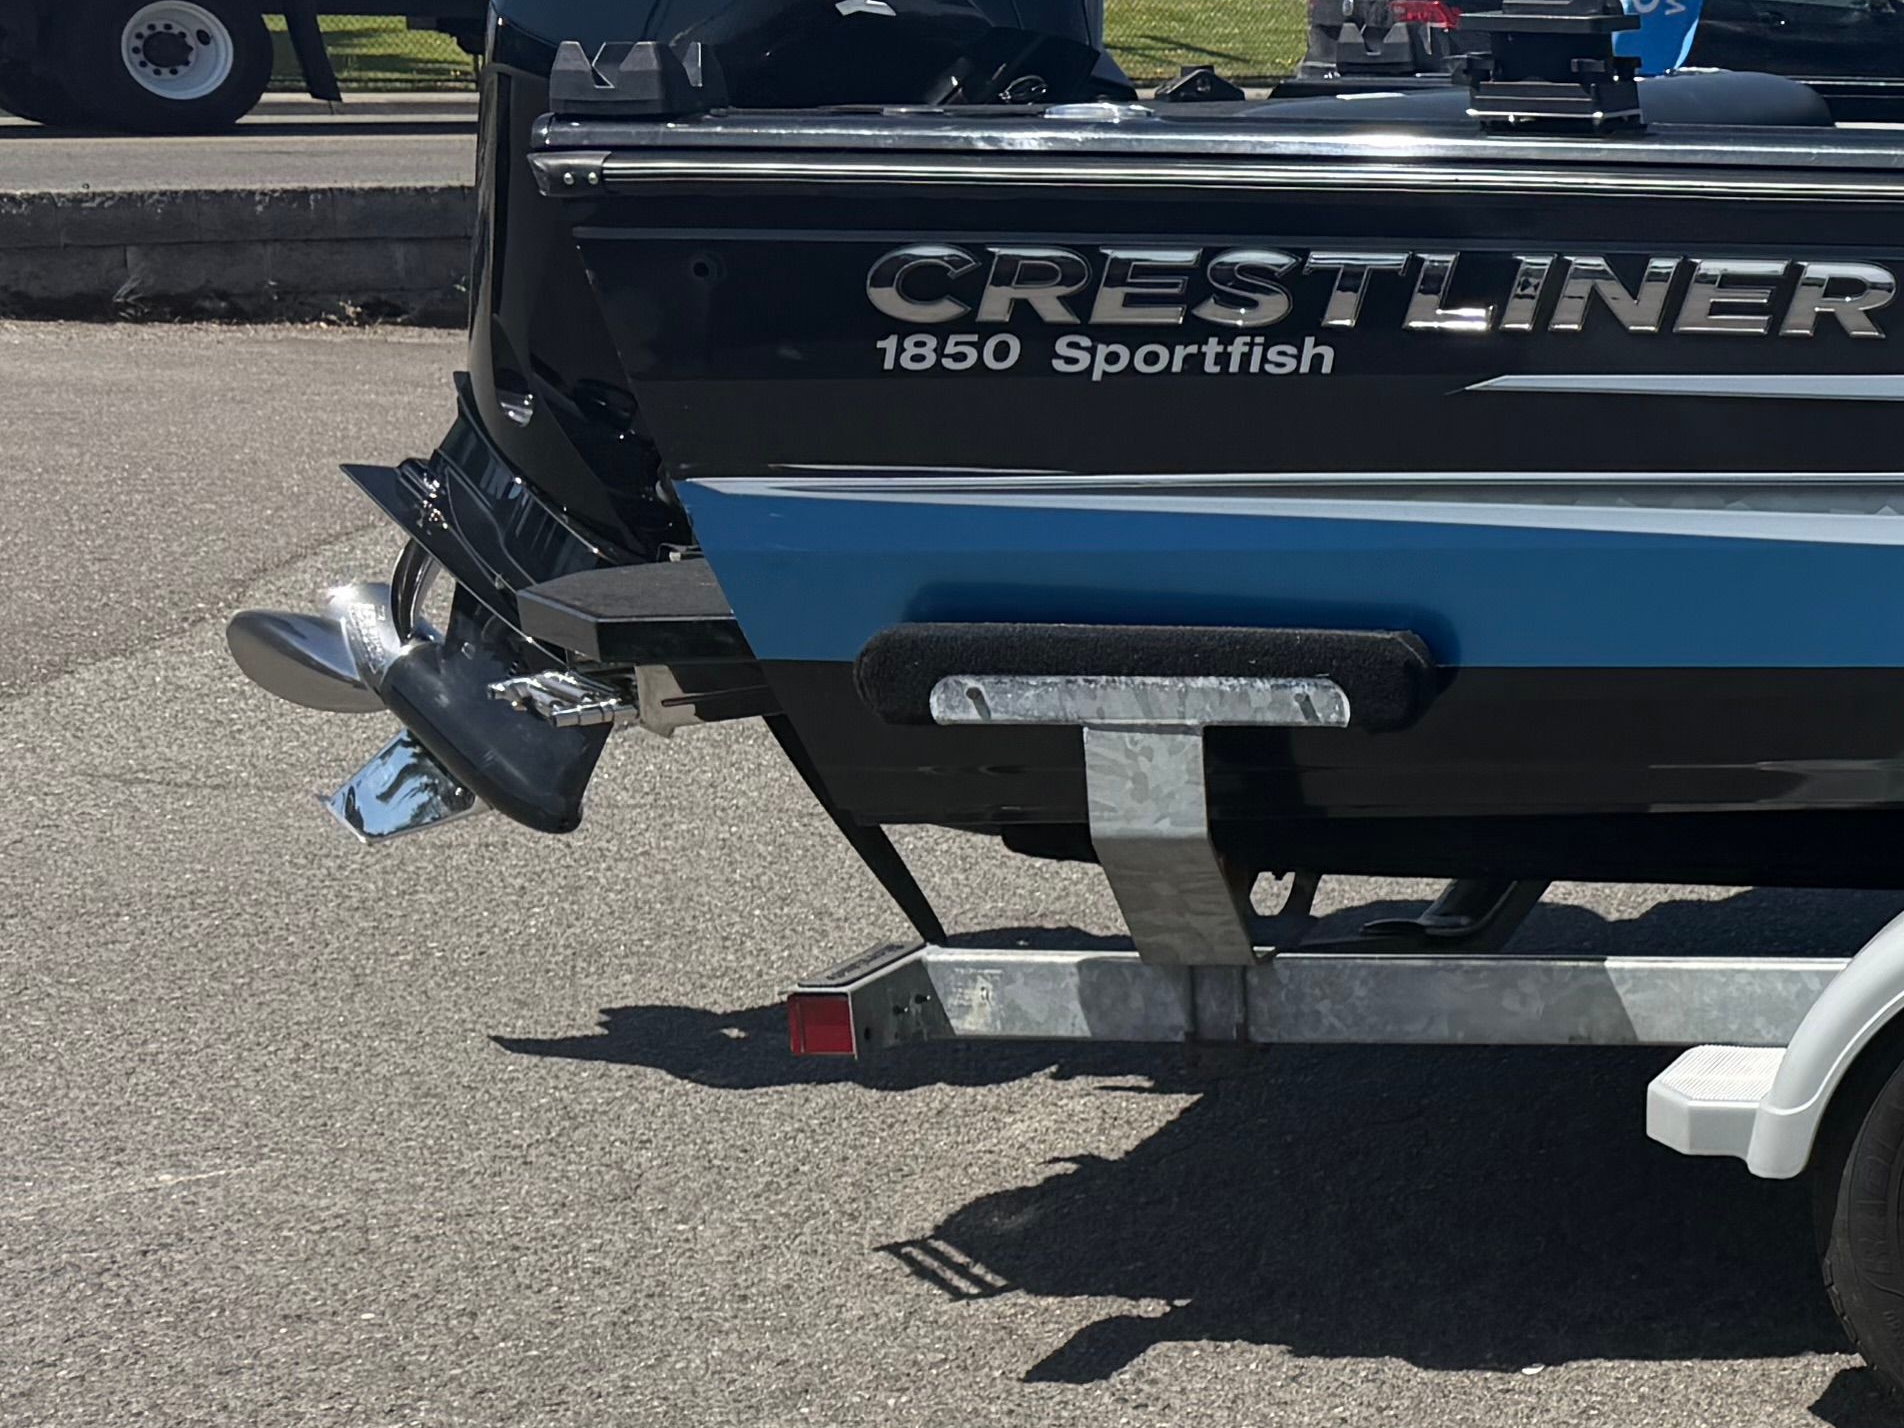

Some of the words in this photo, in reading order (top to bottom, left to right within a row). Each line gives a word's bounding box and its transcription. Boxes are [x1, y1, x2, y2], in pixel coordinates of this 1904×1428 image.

[864, 243, 1898, 341] CRESTLINER
[876, 334, 1021, 371] 1850
[1051, 334, 1335, 381] Sportfish
